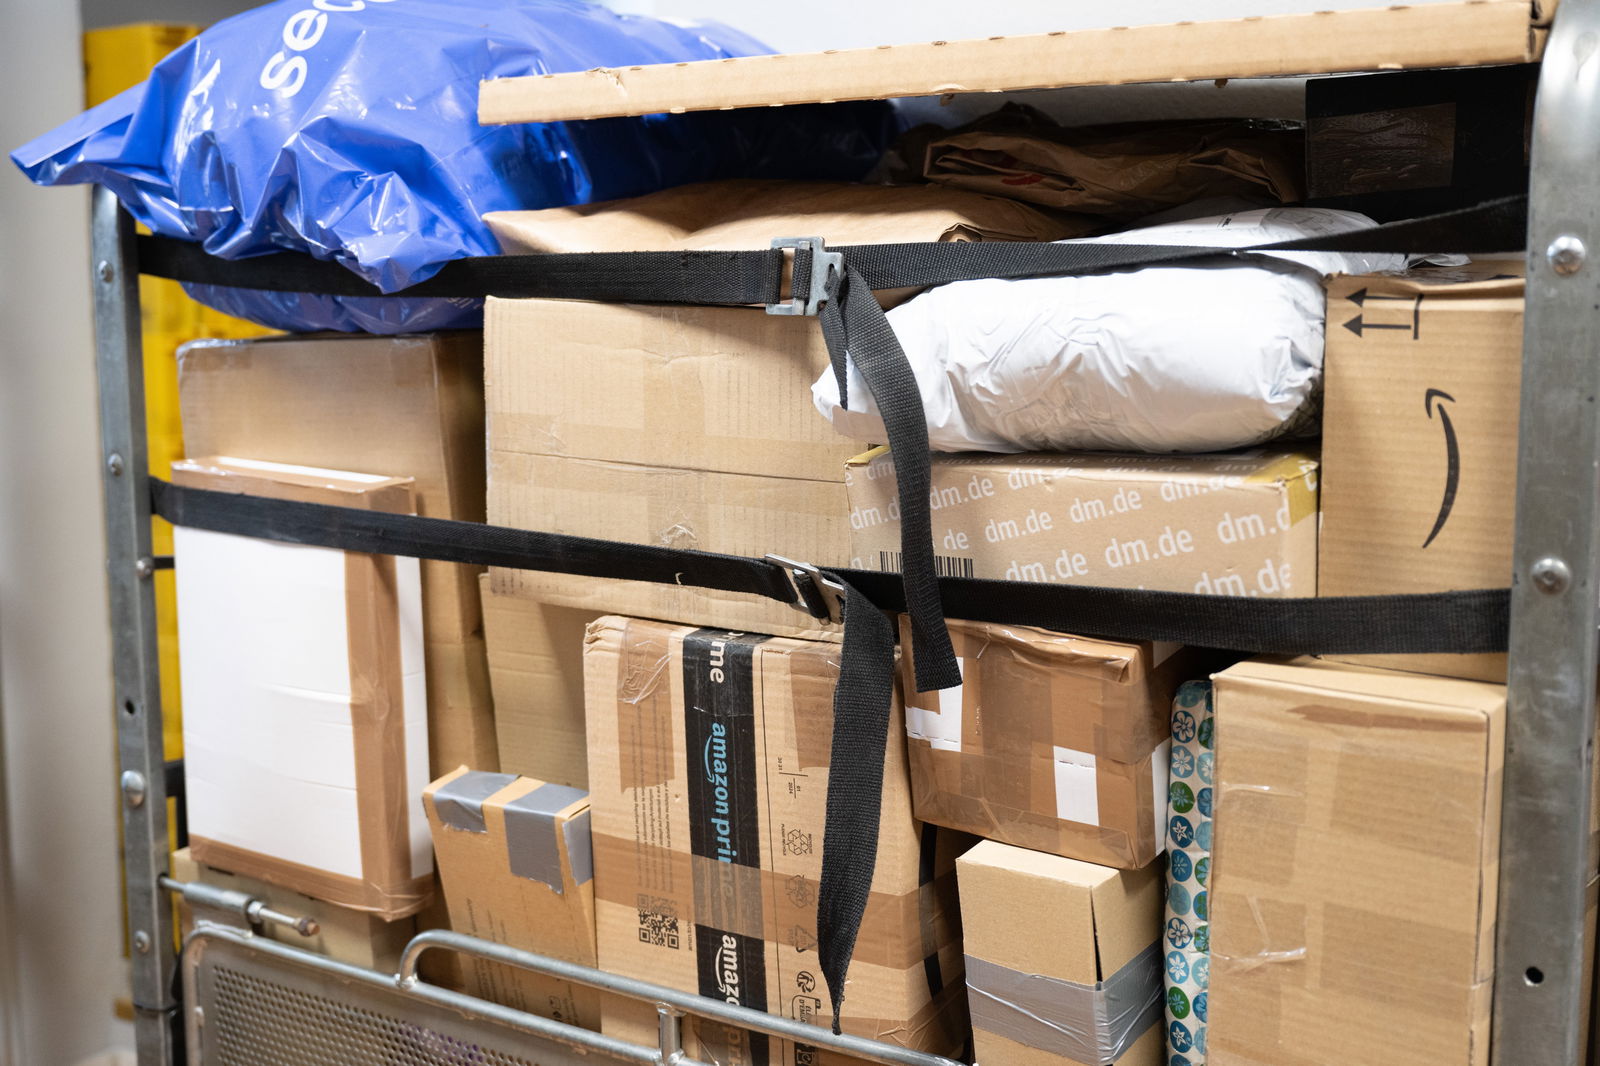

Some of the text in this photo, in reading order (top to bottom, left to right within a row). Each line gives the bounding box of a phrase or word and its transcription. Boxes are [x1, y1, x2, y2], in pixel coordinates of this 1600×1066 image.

[1069, 486, 1143, 524] dm.de
[985, 508, 1053, 543] dm.de
[1105, 526, 1194, 568] dm.de
[712, 722, 729, 814] amazon
